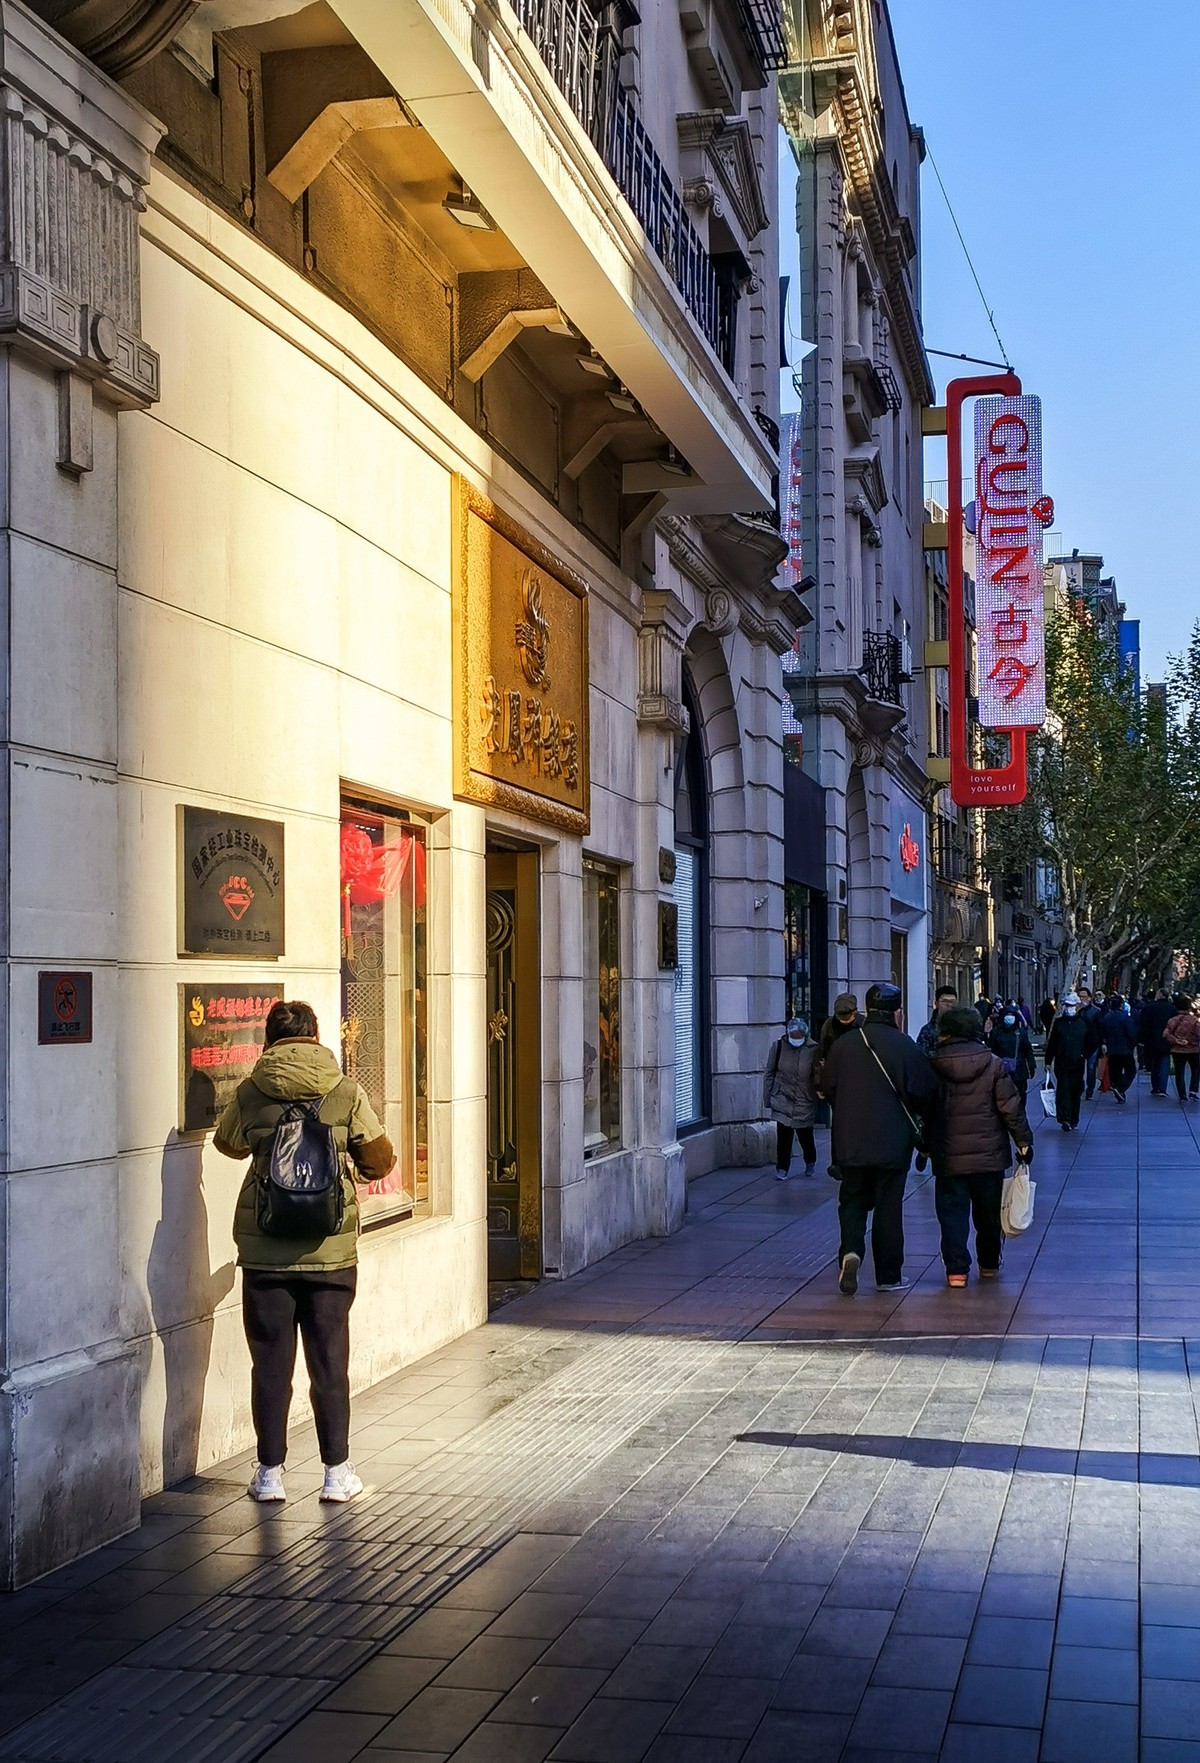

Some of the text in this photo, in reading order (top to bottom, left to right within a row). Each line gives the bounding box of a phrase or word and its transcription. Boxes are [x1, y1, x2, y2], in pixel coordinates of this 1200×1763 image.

[987, 602, 1040, 700] 古今
[970, 775, 993, 783] love
[971, 783, 1017, 794] yourself
